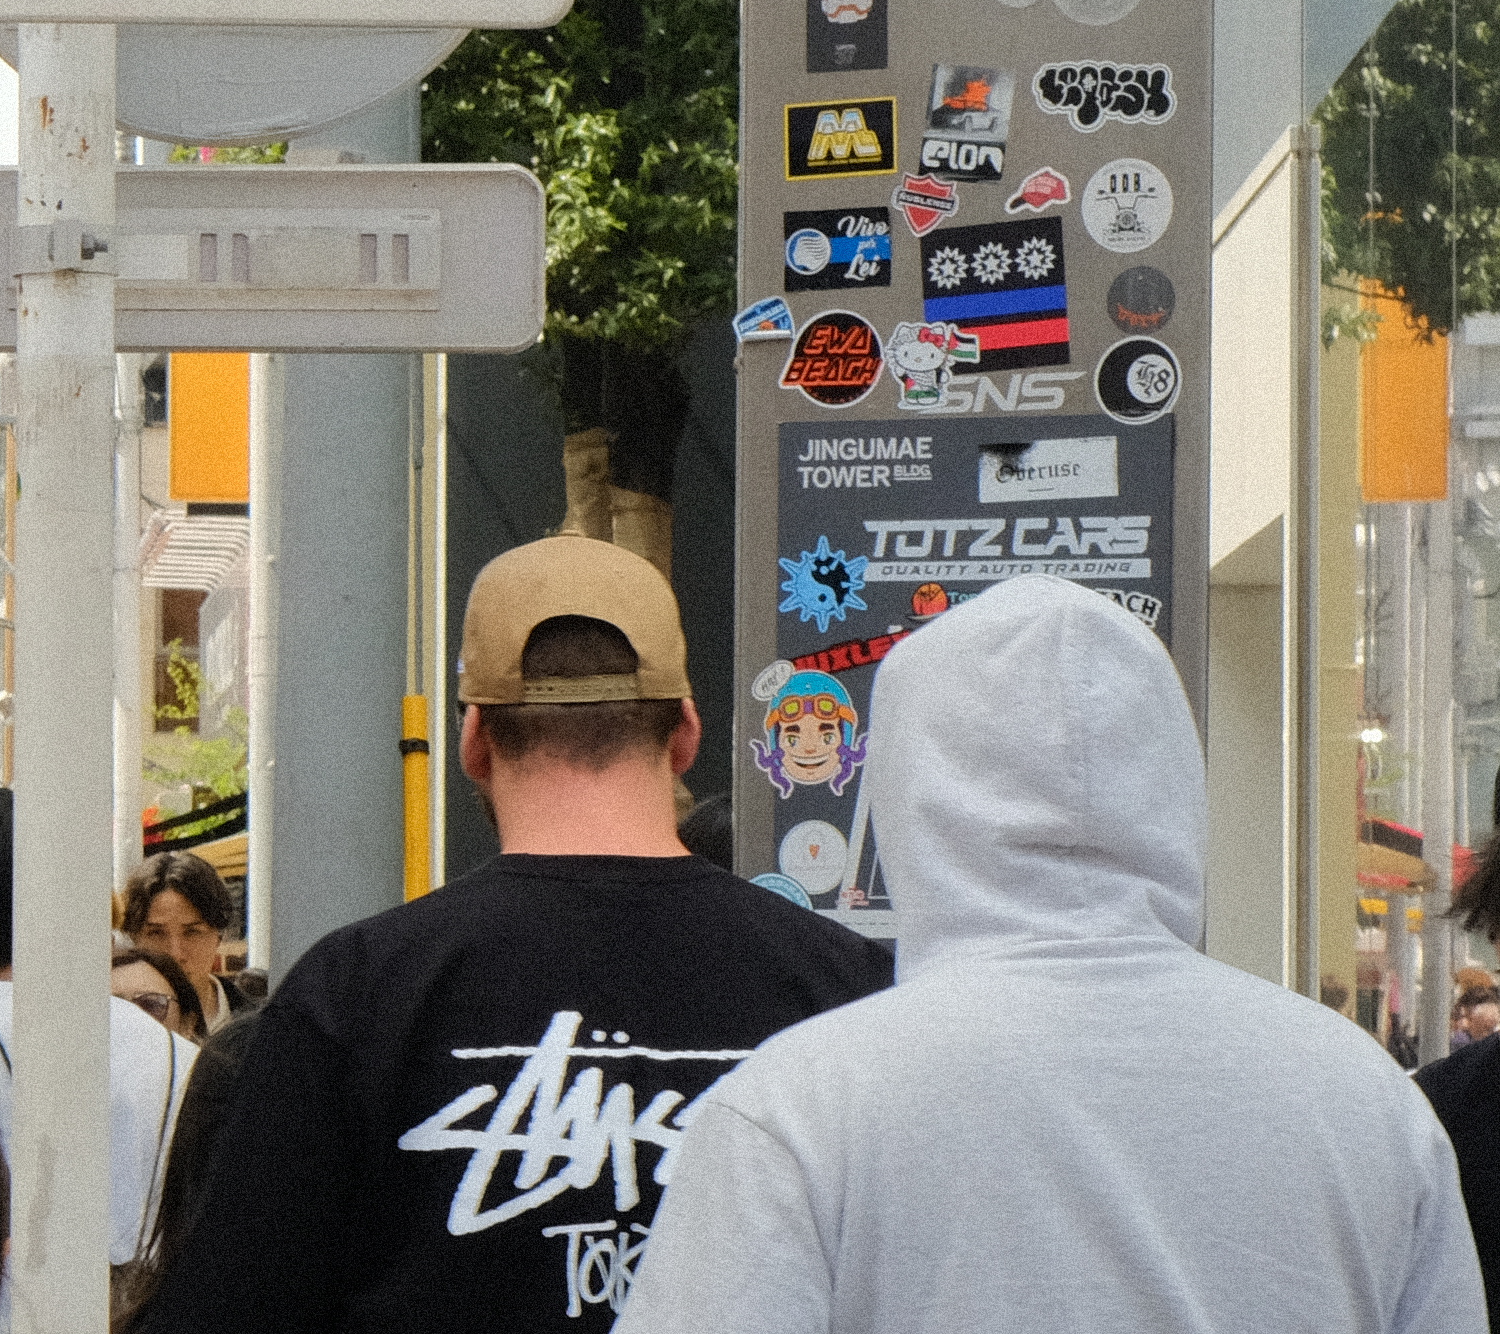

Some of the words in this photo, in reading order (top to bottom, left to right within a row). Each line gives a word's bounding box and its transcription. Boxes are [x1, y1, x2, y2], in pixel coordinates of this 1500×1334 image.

[798, 436, 933, 463] JINGUMAE
[796, 465, 892, 489] TOWER
[1012, 515, 1152, 555] CARS
[541, 1218, 653, 1319] TOK
